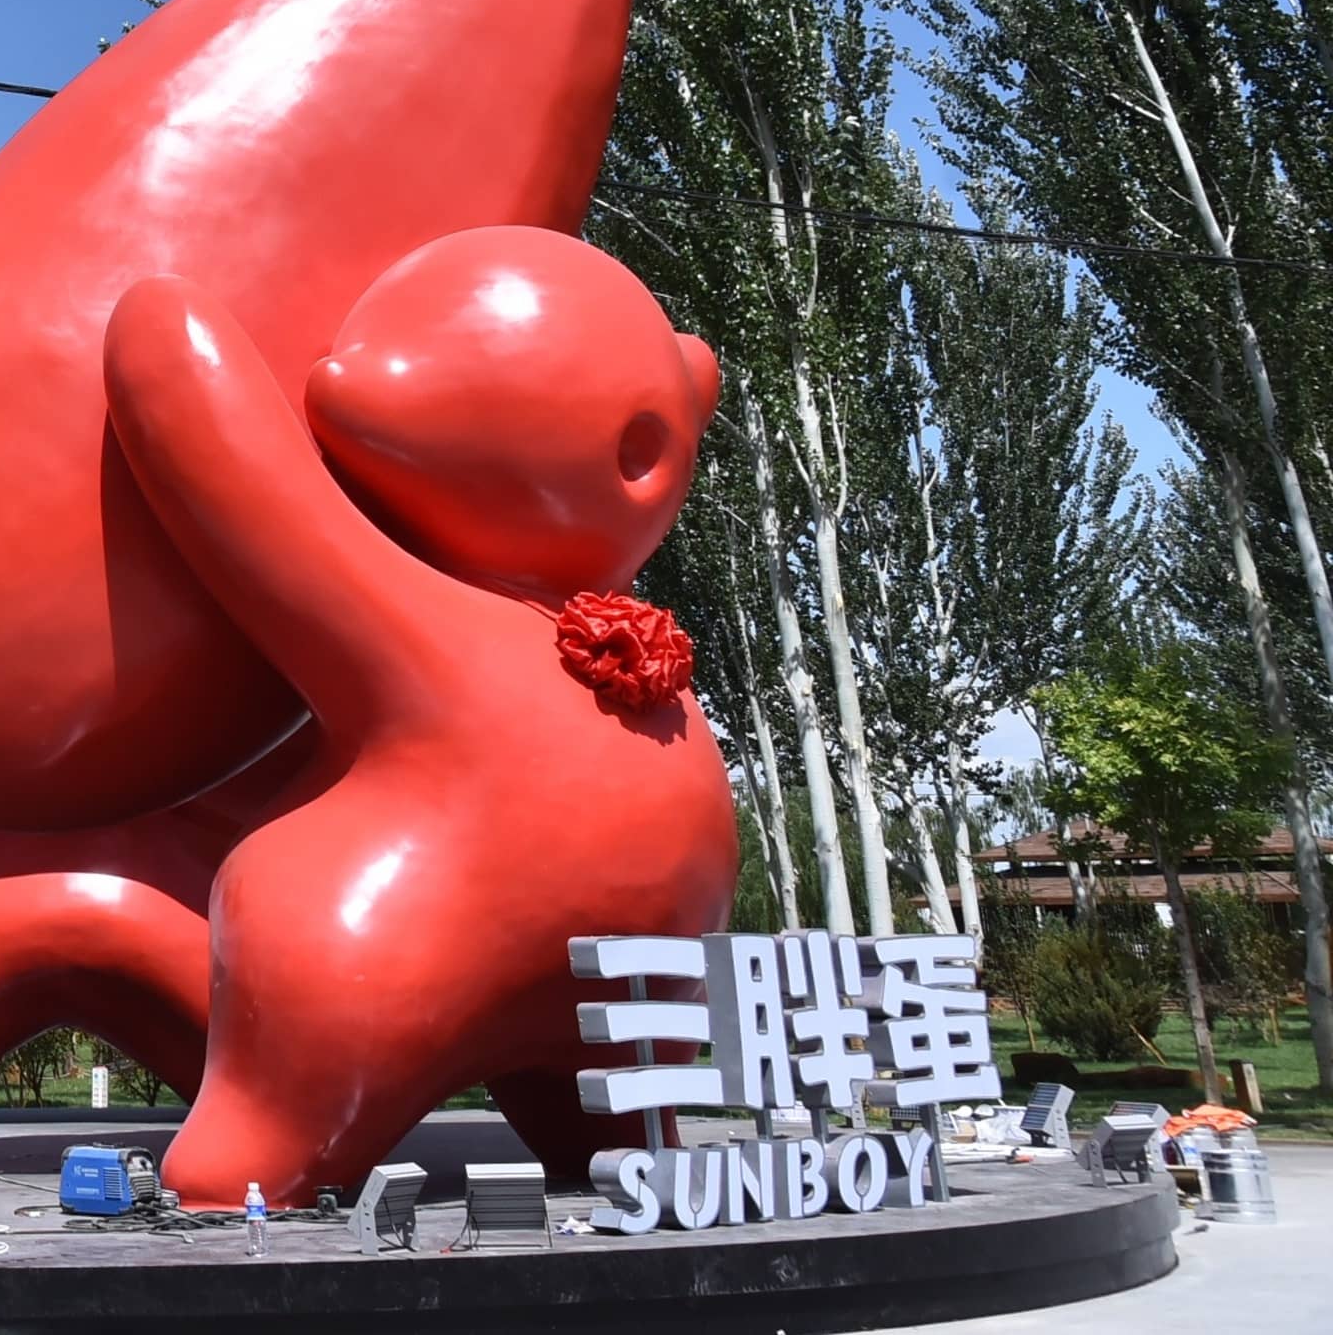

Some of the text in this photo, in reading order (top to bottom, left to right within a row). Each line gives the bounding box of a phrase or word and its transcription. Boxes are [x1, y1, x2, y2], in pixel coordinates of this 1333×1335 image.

[569, 929, 1002, 1114] 三胖蛋
[590, 1127, 933, 1235] SUNBOY
